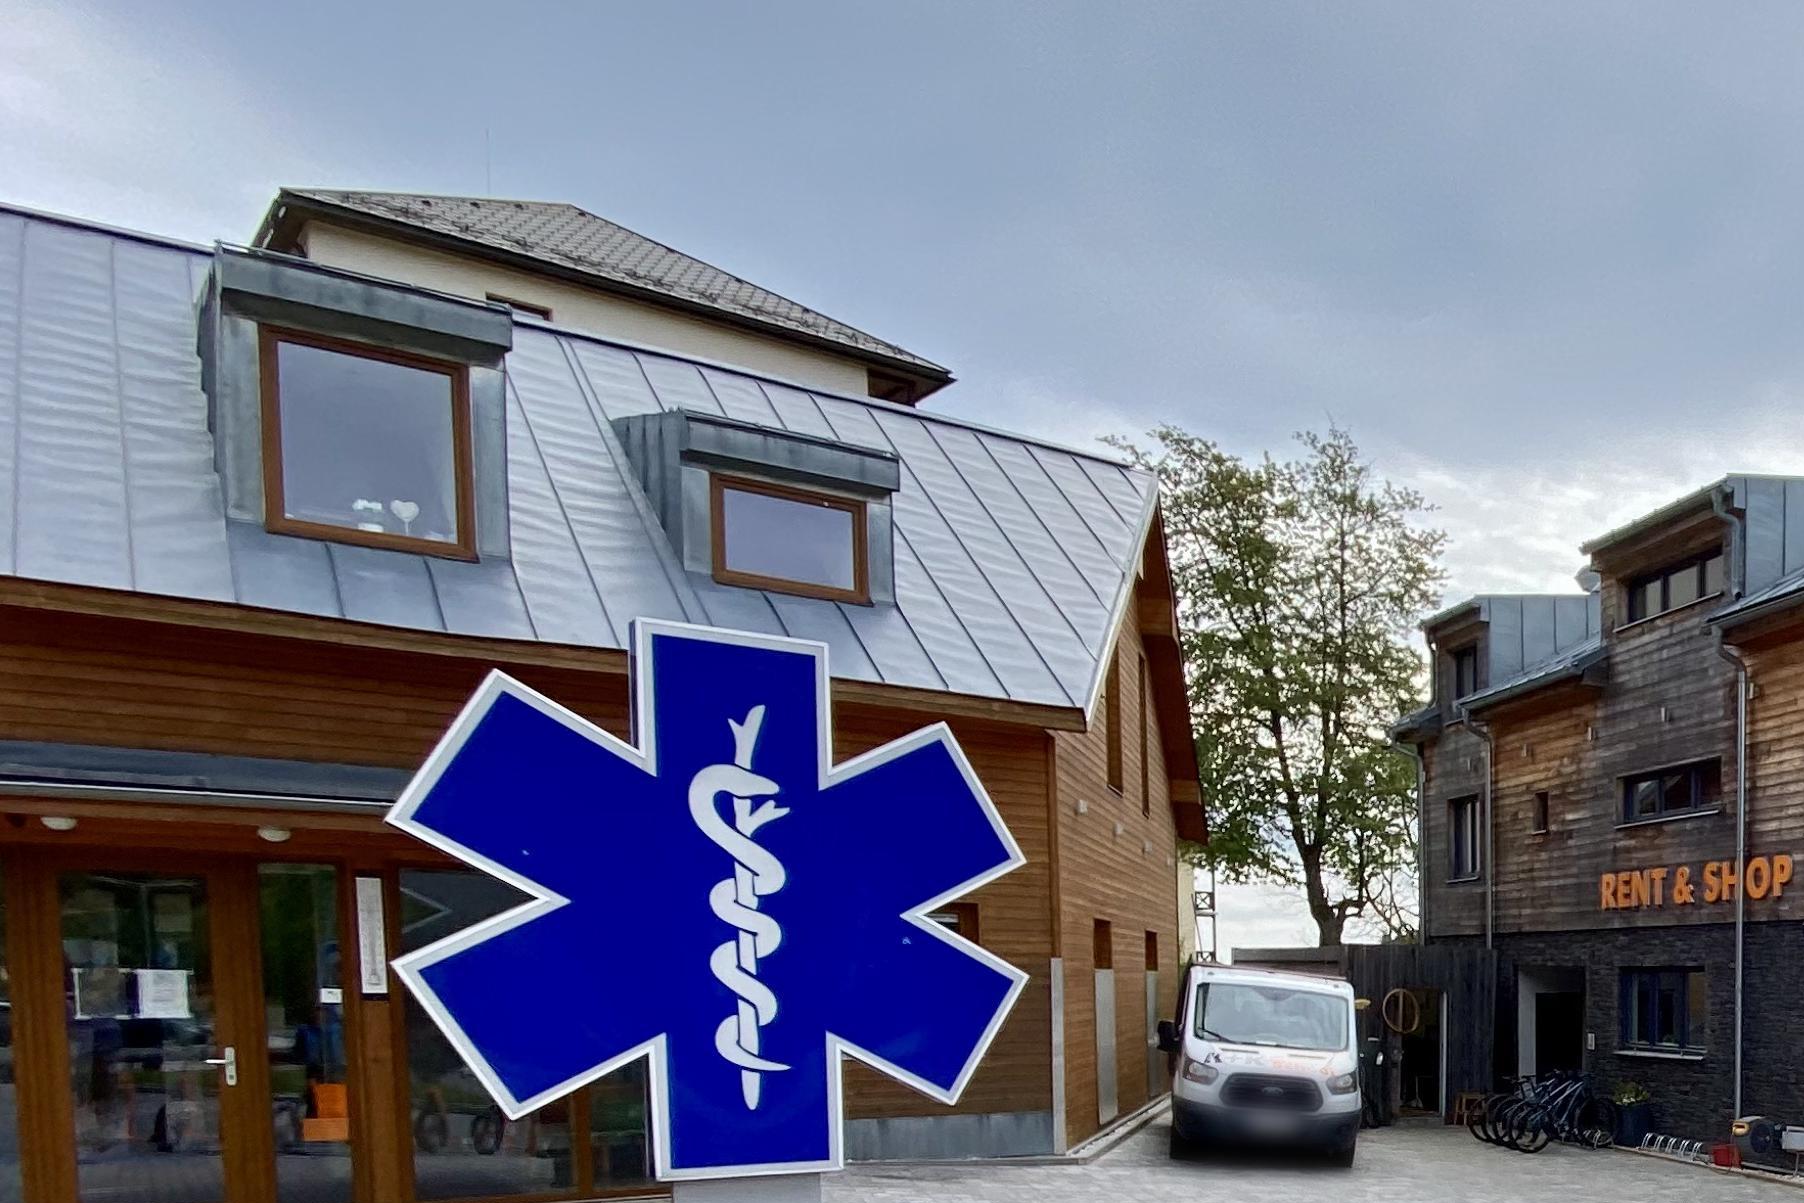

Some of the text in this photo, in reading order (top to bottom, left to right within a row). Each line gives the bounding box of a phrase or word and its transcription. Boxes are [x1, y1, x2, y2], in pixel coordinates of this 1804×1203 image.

[1601, 854, 1793, 909] RENT & SHOP
